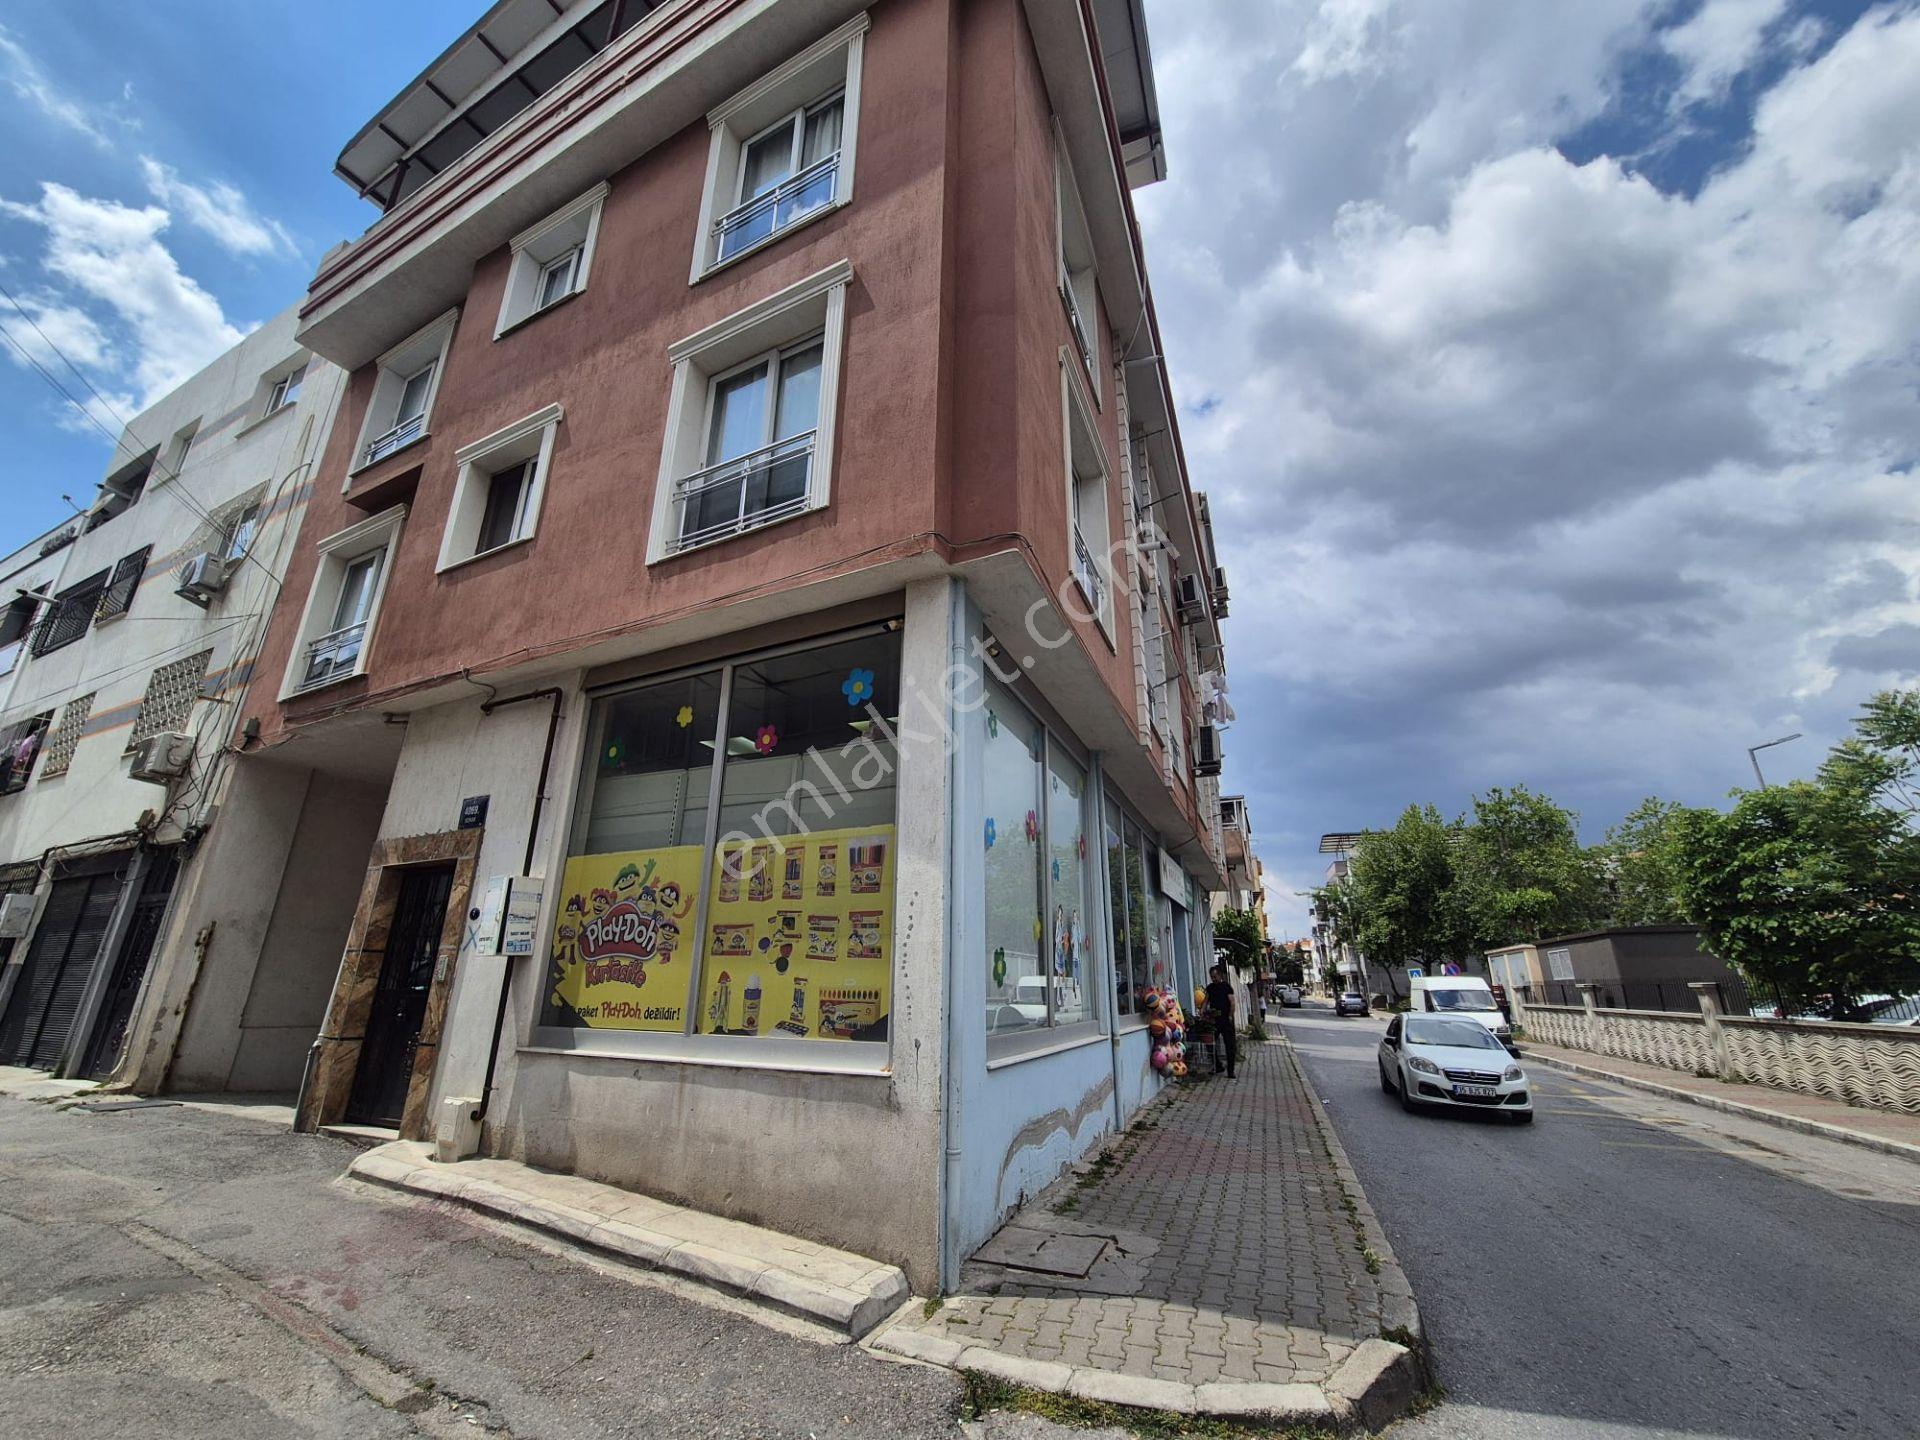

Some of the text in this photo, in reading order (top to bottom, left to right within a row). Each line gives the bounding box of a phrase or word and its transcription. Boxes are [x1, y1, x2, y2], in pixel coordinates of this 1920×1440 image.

[585, 913, 657, 953] Play-Doh
[577, 1005, 600, 1018] paket
[600, 1001, 642, 1020] Play-Doh
